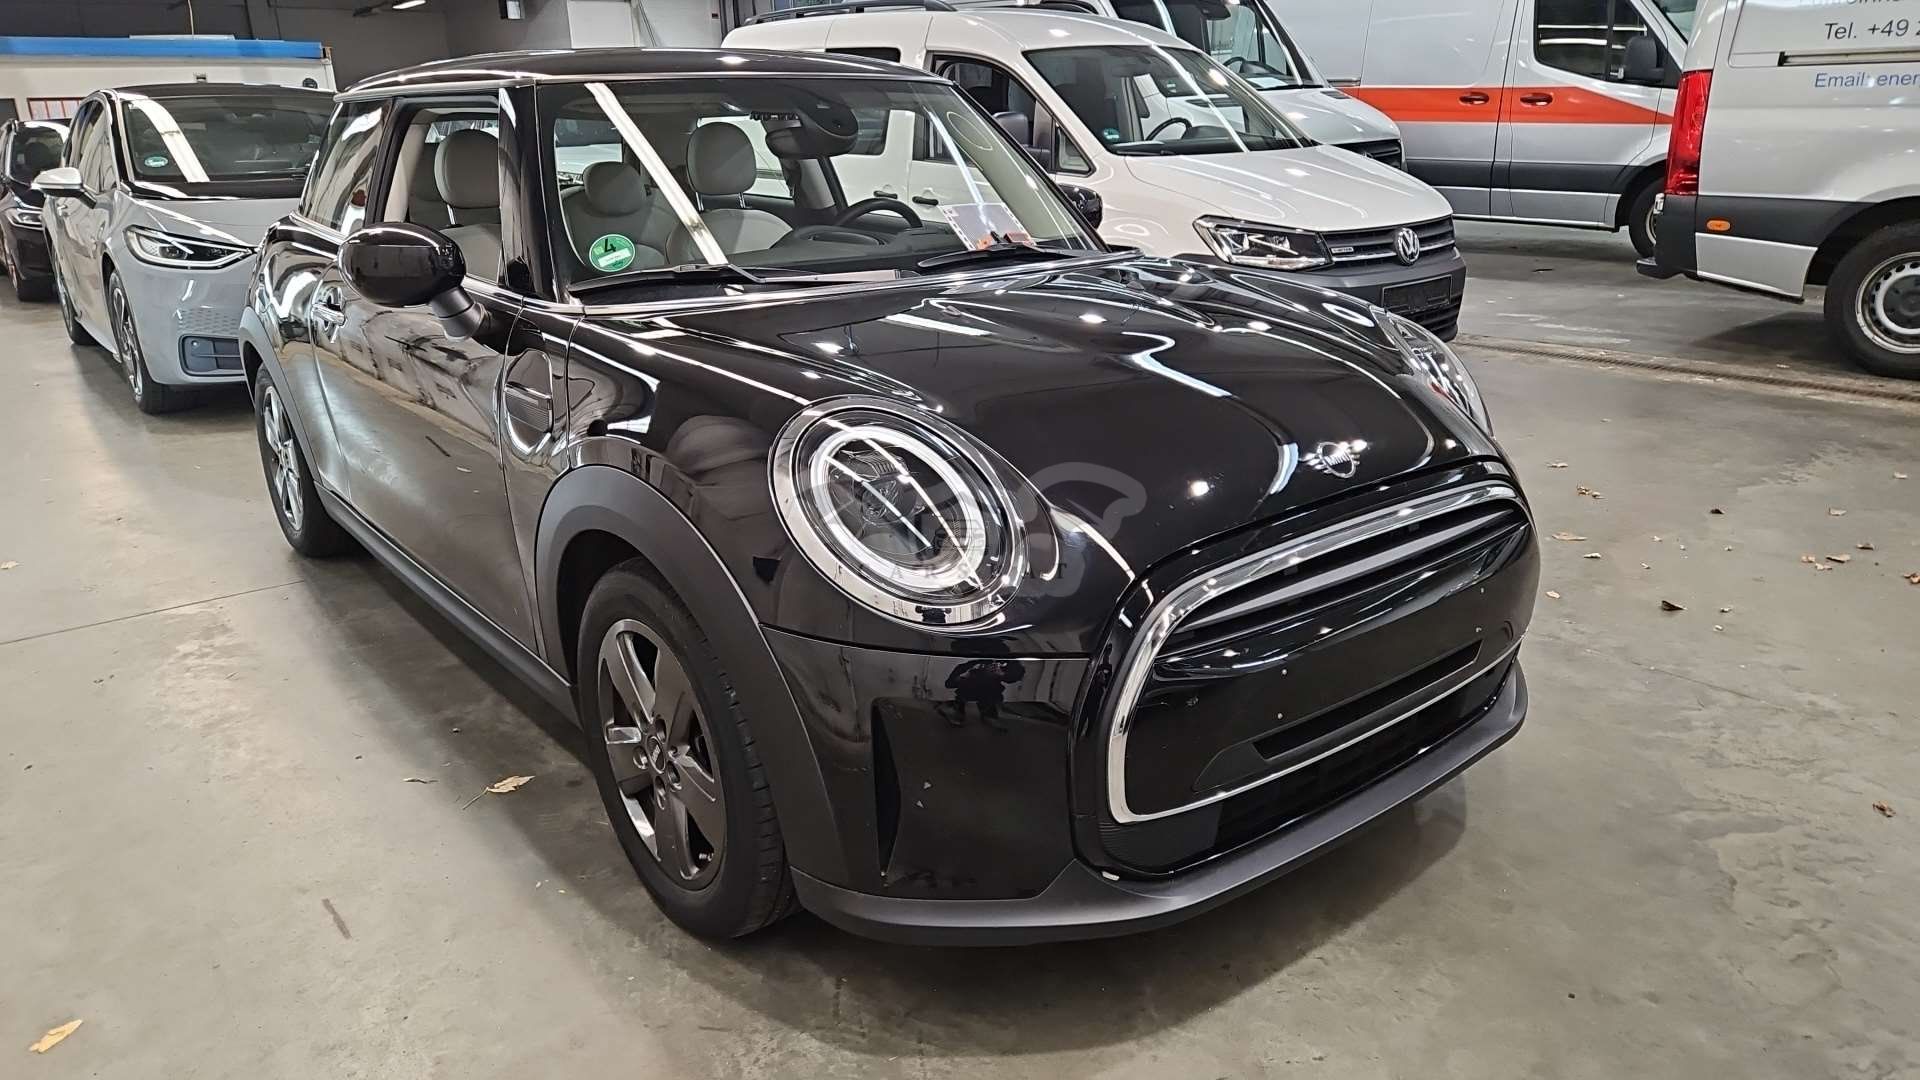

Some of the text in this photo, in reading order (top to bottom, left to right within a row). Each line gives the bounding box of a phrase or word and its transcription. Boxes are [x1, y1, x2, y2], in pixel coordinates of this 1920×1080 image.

[1825, 22, 1857, 40] Tel.
[1868, 19, 1909, 37] +49
[1877, 73, 1920, 88] ener
[604, 238, 617, 253] 4
